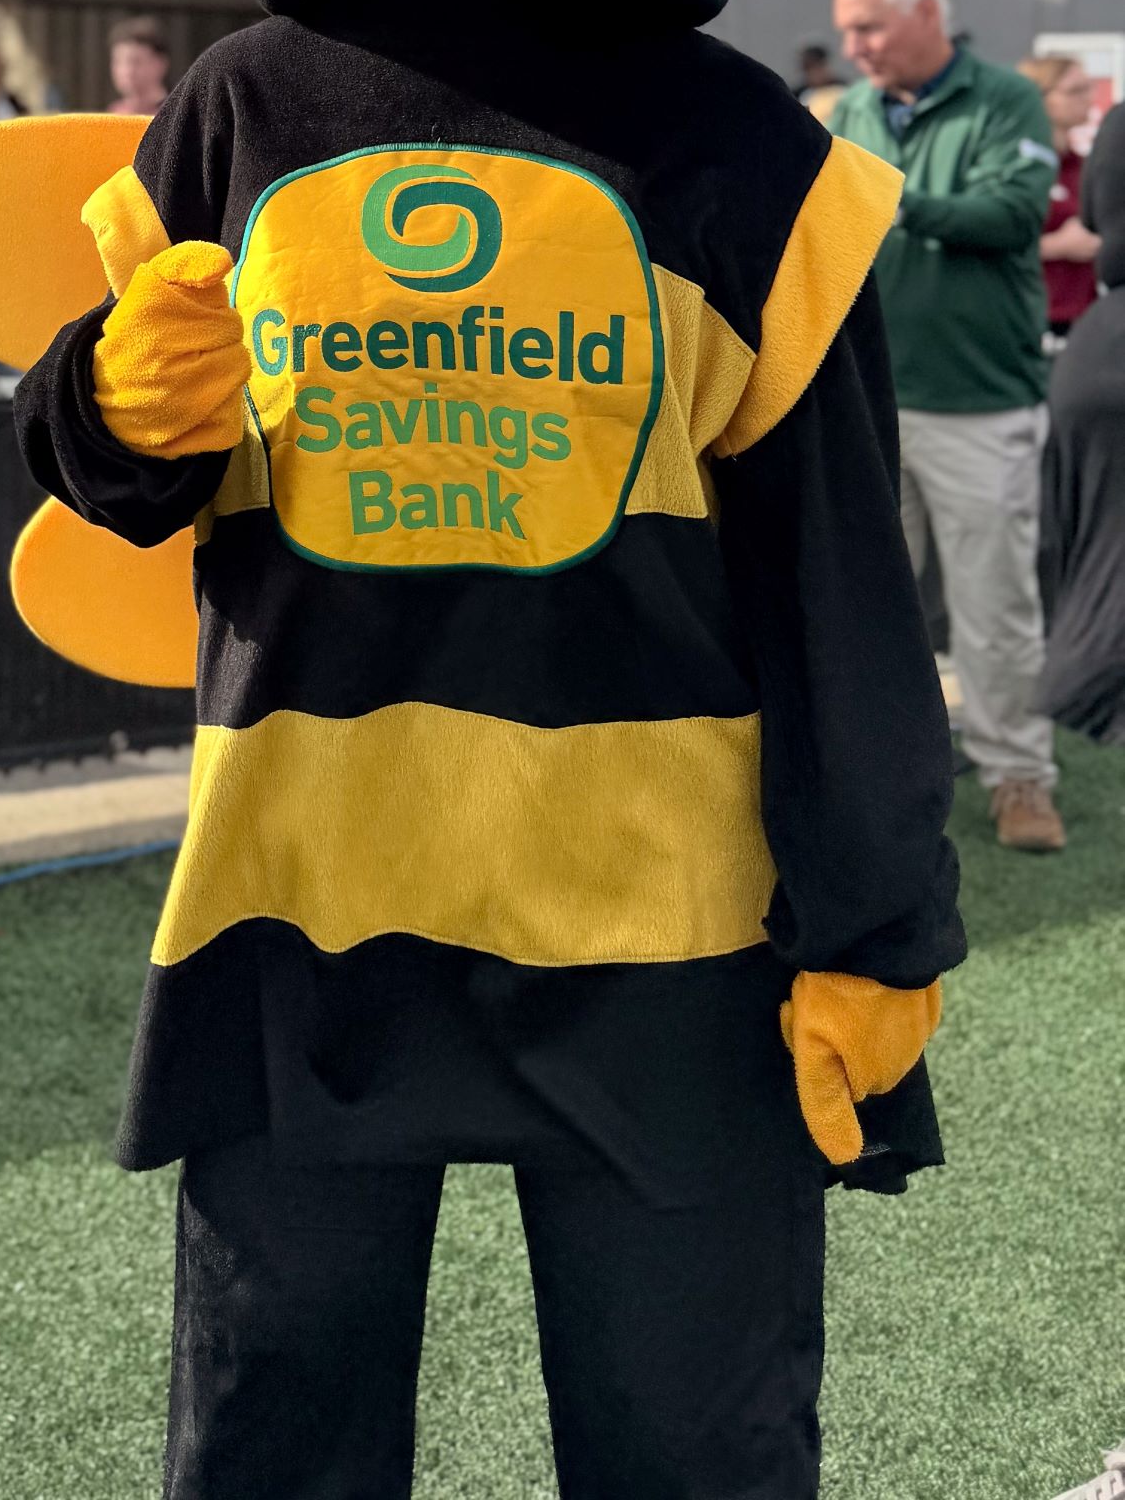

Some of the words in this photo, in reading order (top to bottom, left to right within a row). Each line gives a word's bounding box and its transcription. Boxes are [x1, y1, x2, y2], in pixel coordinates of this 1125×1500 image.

[251, 305, 625, 385] Greenfield
[294, 383, 572, 469] Savings
[348, 469, 528, 541] Bank
